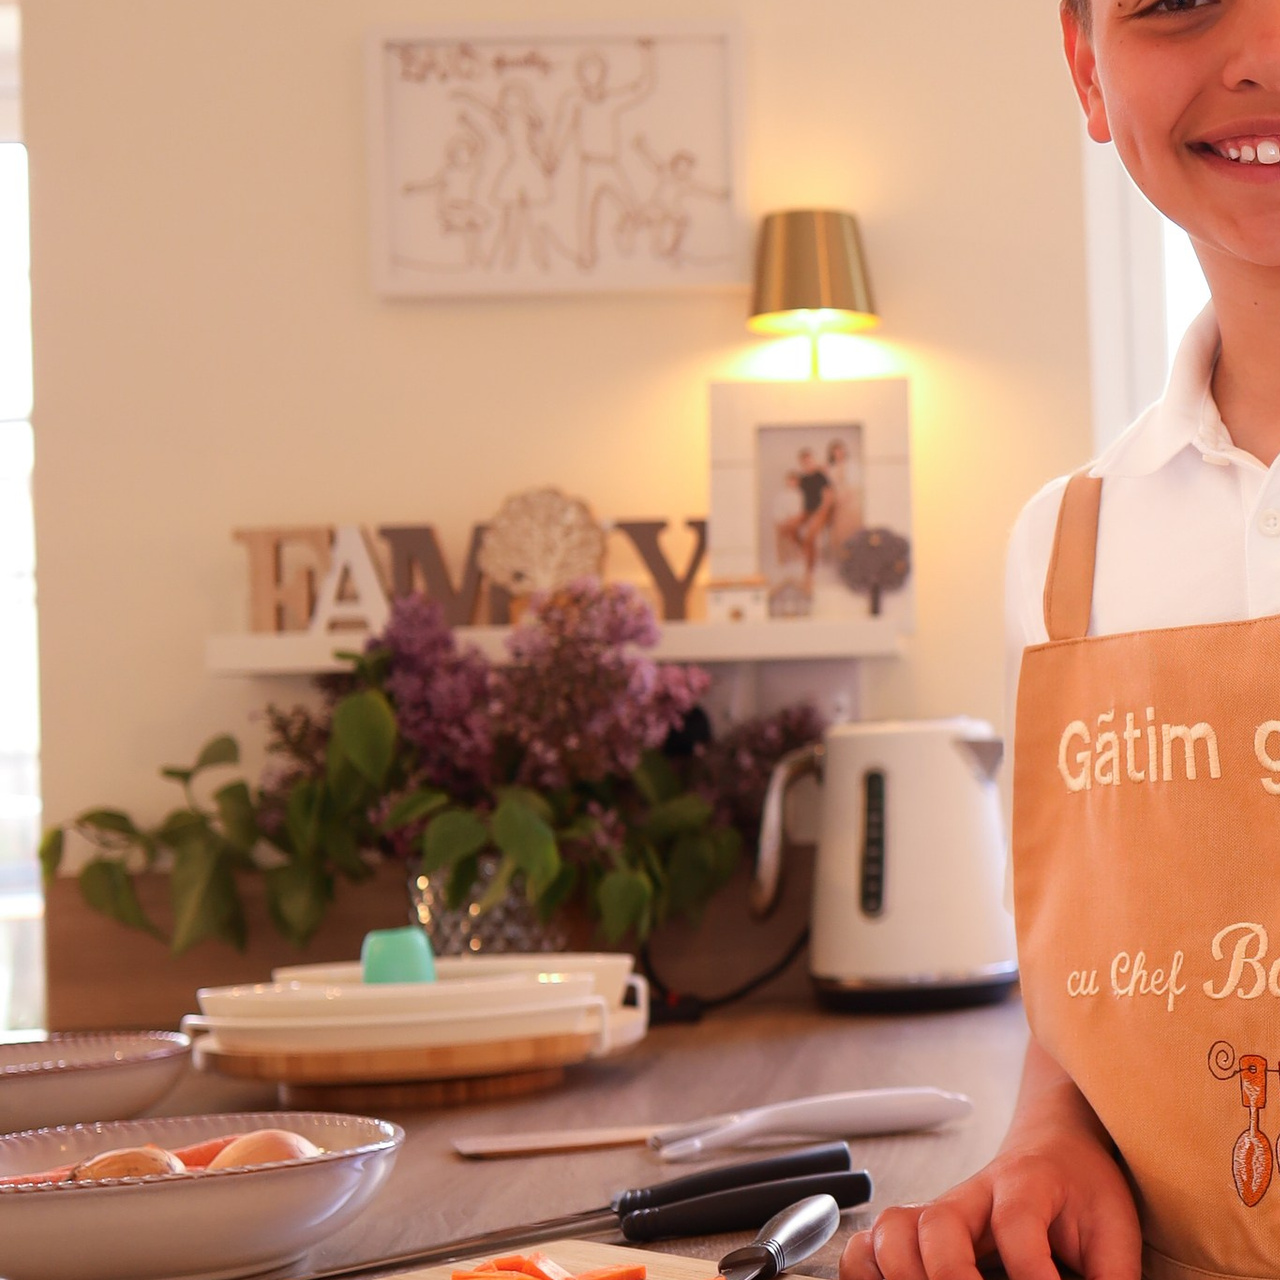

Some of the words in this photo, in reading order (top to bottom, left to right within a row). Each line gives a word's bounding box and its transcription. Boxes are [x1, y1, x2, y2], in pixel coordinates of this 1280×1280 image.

[230, 516, 708, 636] FAMY
[1067, 968, 1099, 997] cu
[1110, 949, 1187, 1013] Chef
